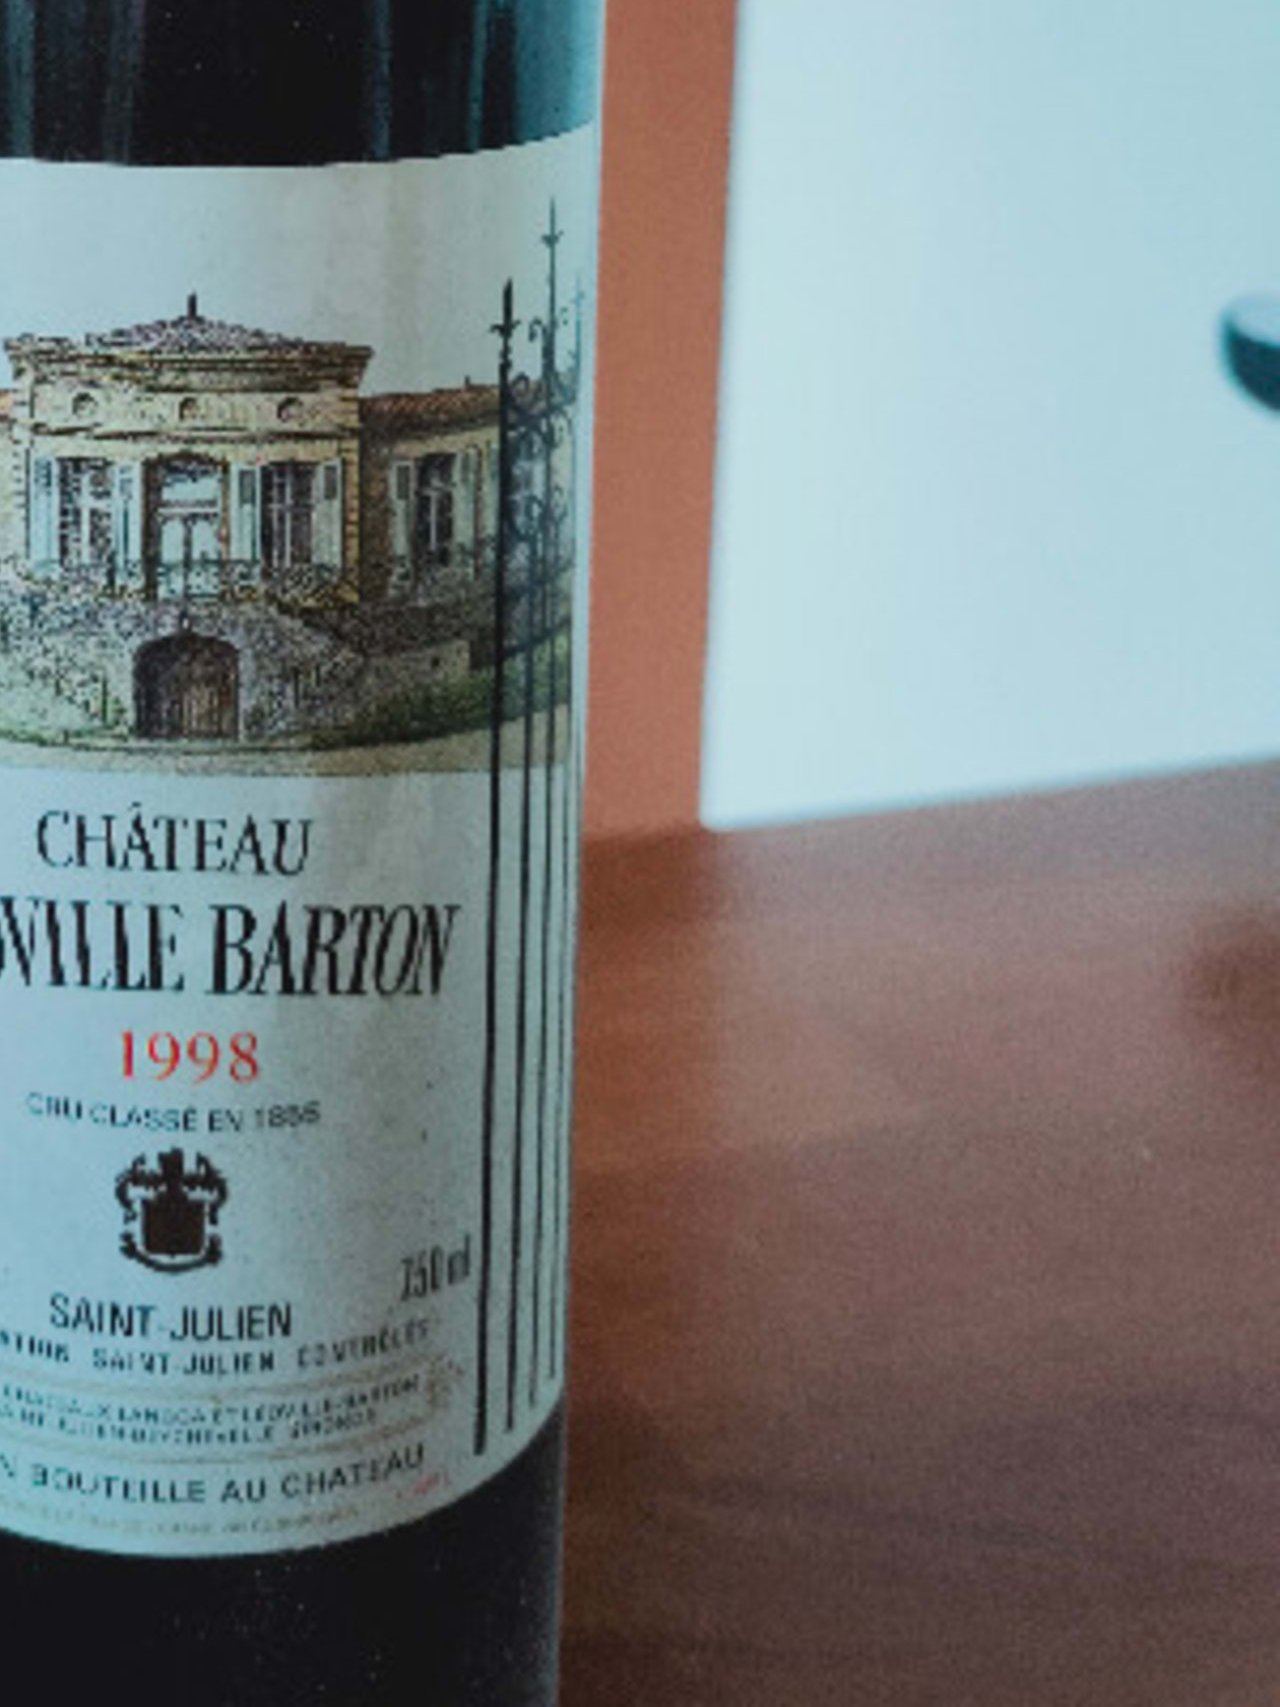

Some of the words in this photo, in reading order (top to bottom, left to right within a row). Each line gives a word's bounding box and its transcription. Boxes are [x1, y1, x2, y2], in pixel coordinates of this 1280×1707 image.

[37, 802, 314, 877] CHÂTEAU
[205, 899, 461, 996] BARTON
[122, 1031, 260, 1084] 1998
[26, 1092, 83, 1122] CRU
[208, 1107, 242, 1133] EN
[31, 1464, 206, 1503] BOUTEILLE
[220, 1478, 267, 1503] AU
